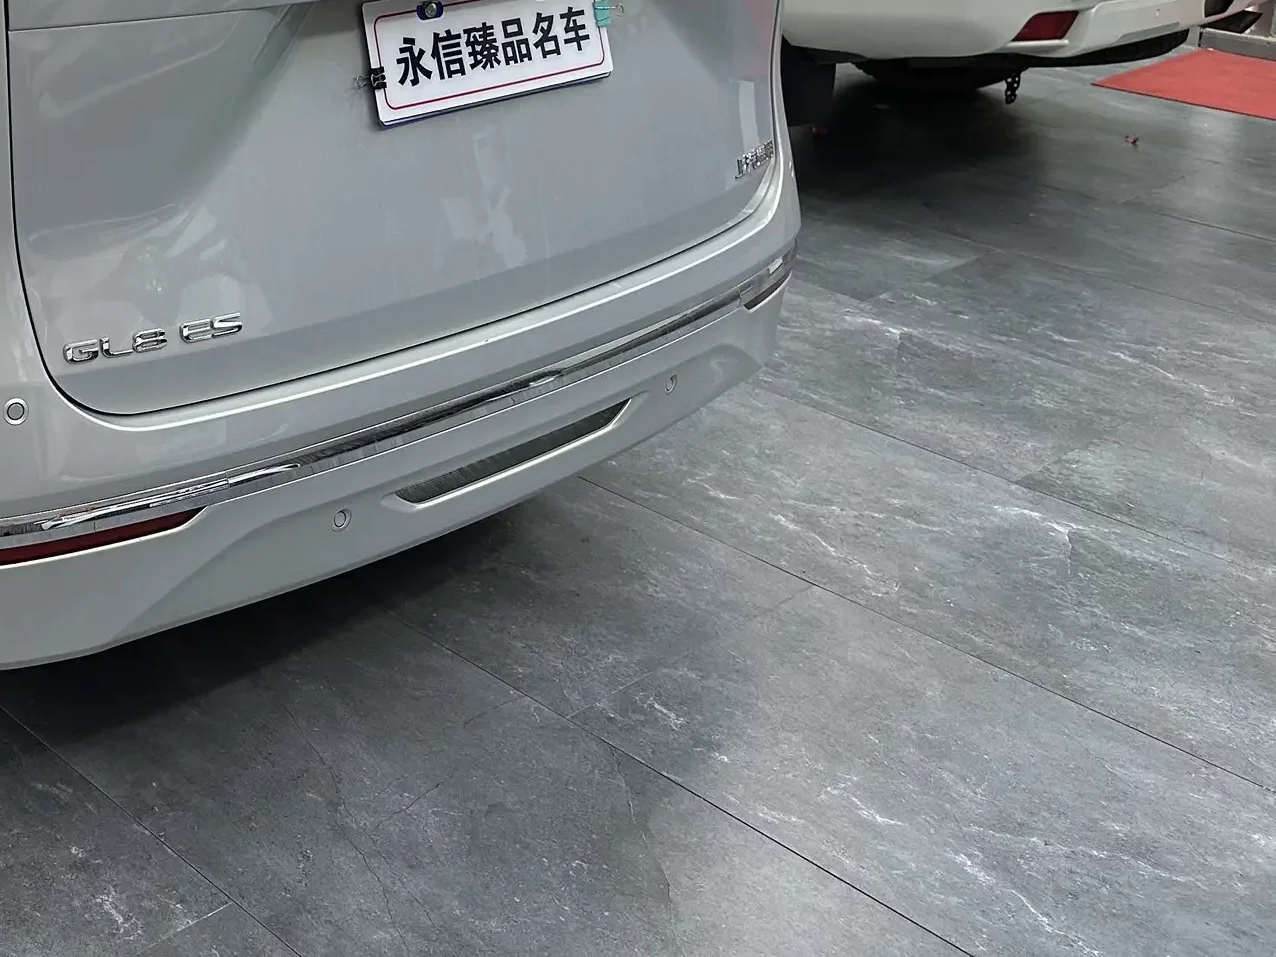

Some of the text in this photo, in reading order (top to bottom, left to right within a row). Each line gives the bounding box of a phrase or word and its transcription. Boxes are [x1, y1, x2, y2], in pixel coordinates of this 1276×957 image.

[395, 5, 591, 87] 永信臻品名车
[62, 311, 243, 365] GL8 ES
